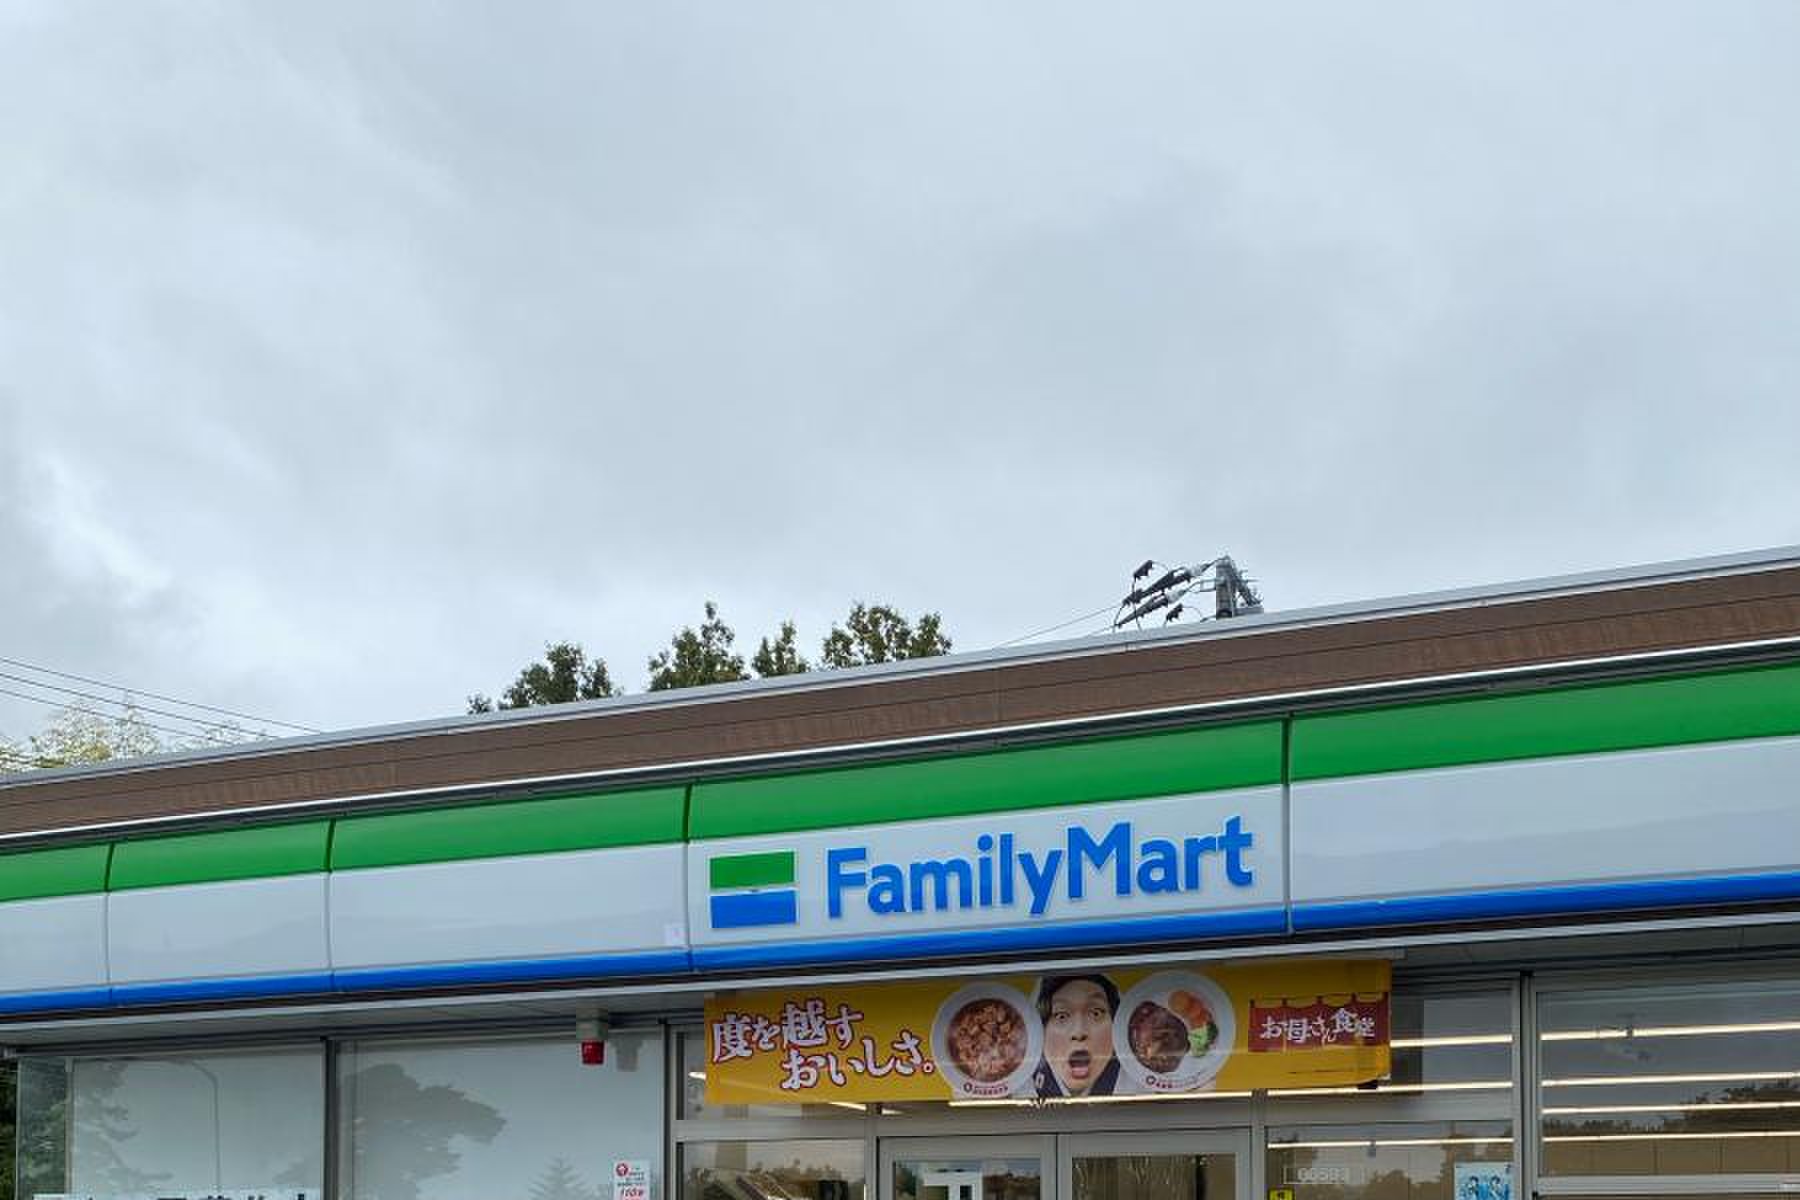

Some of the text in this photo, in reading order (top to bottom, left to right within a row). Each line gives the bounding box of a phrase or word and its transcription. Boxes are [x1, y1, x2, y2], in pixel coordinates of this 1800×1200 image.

[827, 815, 1254, 918] FamilyMart
[711, 998, 865, 1064] 度を越す
